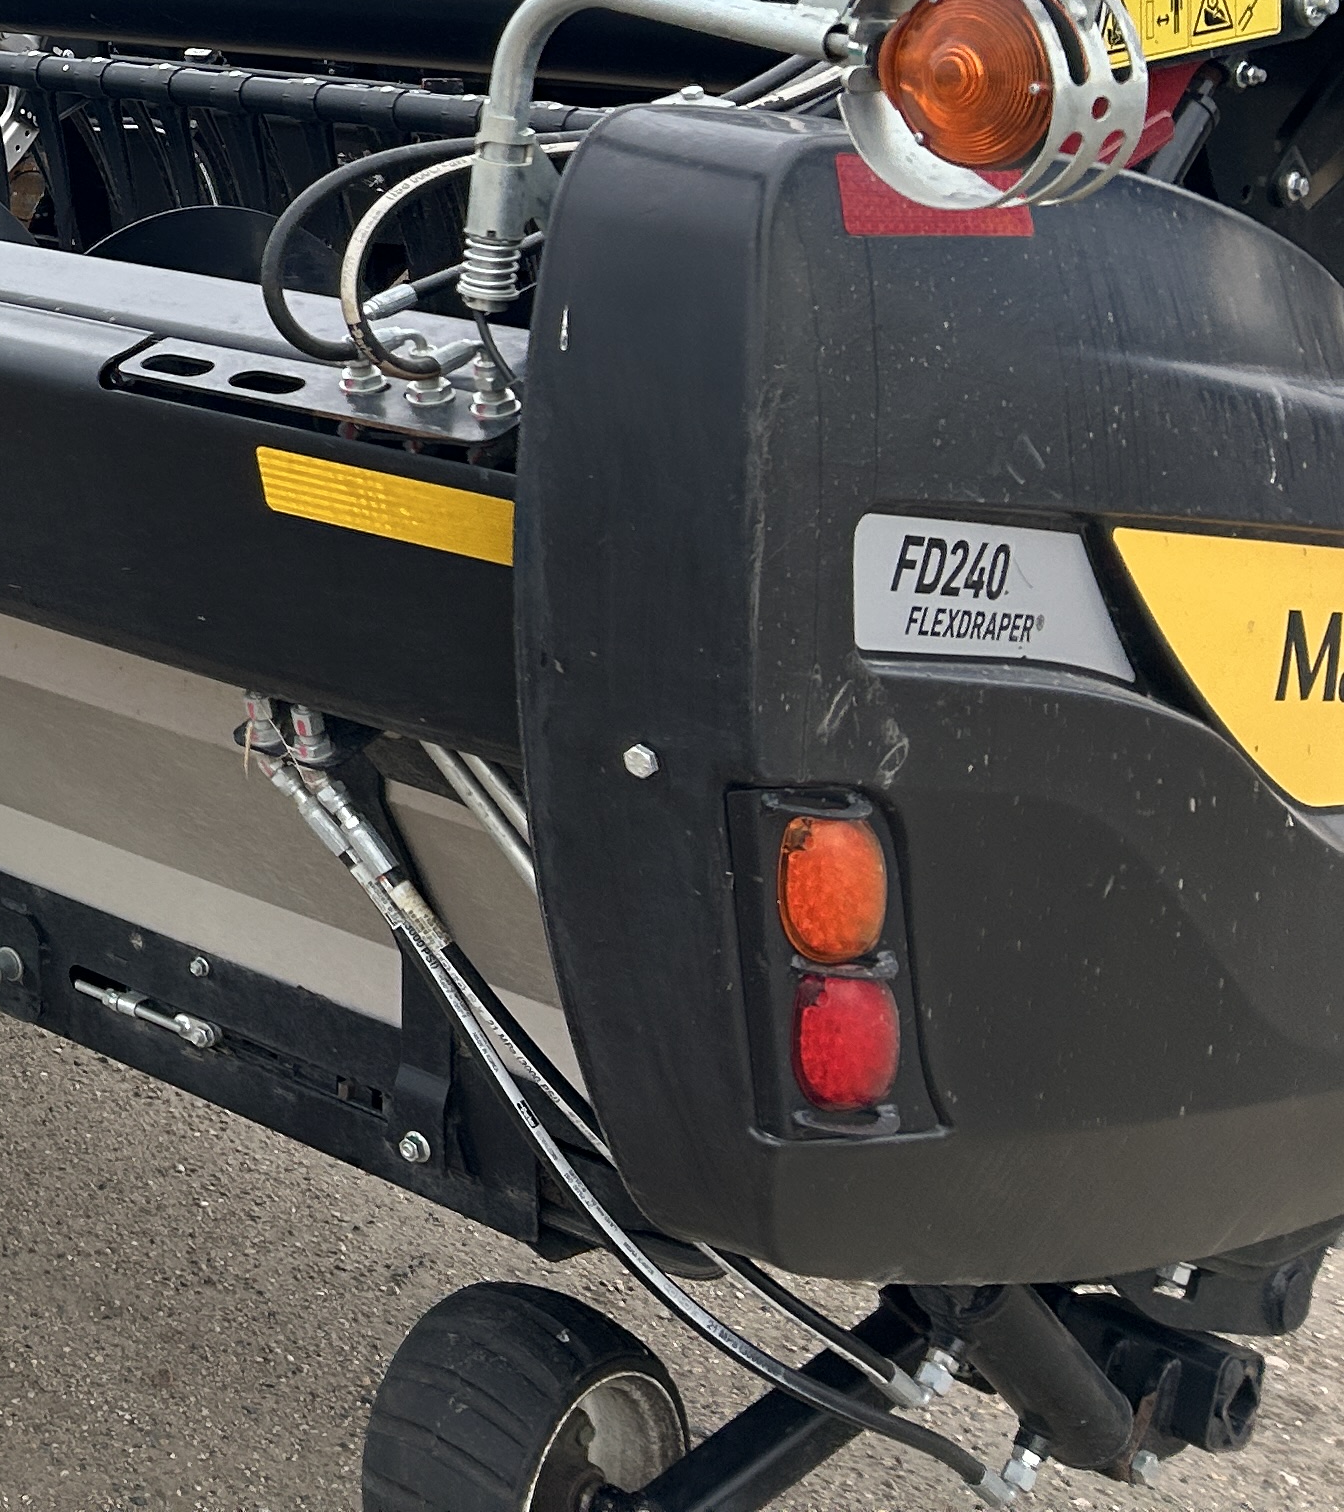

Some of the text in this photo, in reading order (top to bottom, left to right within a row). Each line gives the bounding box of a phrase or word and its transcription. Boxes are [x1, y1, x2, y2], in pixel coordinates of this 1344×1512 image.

[890, 534, 1011, 601] FD240
[1275, 610, 1344, 703] M
[421, 944, 440, 969] PSI)
